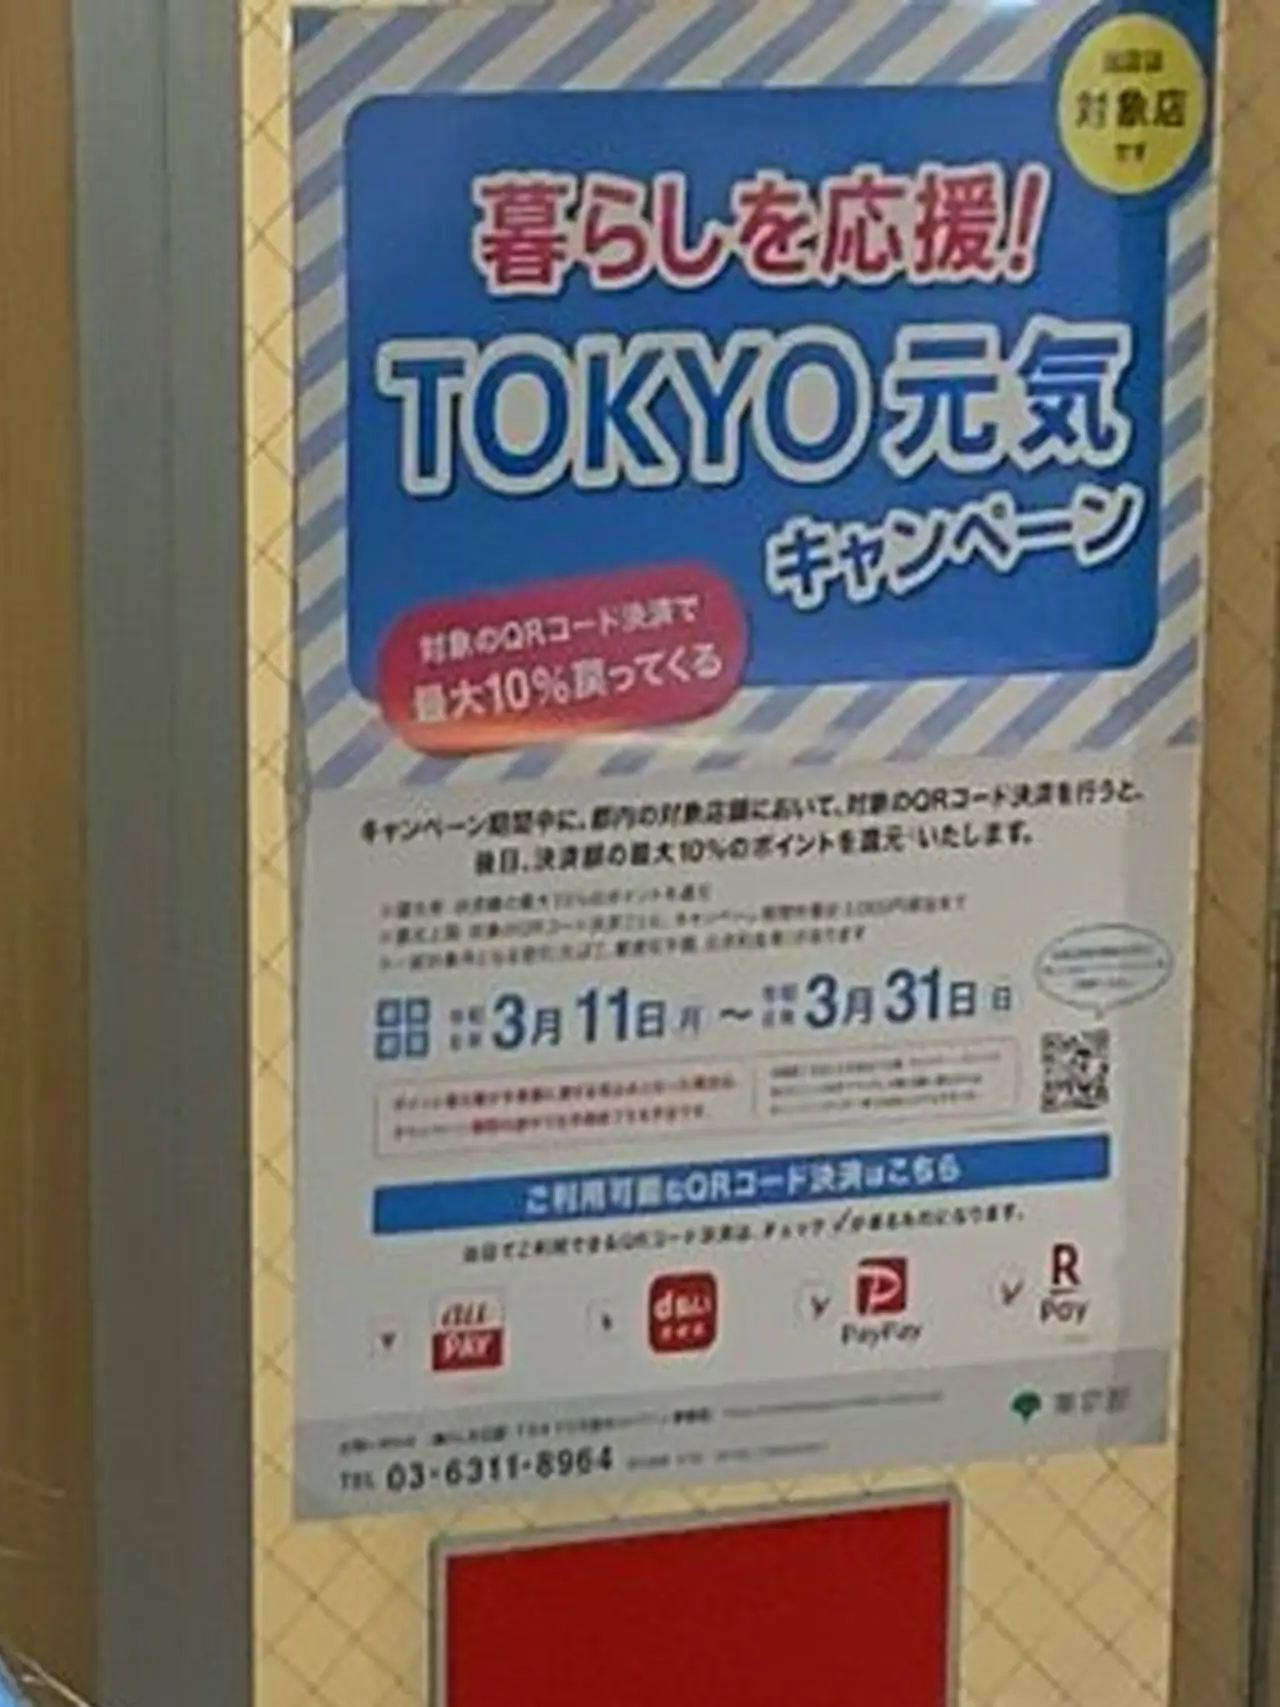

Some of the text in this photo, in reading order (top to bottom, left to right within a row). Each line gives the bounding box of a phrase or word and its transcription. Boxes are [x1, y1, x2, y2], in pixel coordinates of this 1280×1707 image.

[1075, 85, 1188, 130] 対象店
[477, 168, 1048, 292] 暮らしを応援!
[769, 489, 1142, 607] キャンペーン
[419, 595, 700, 663] 対象のQRコード決済で
[414, 642, 723, 722] 最大10%戻ってくる
[841, 1320, 923, 1349] PayPay
